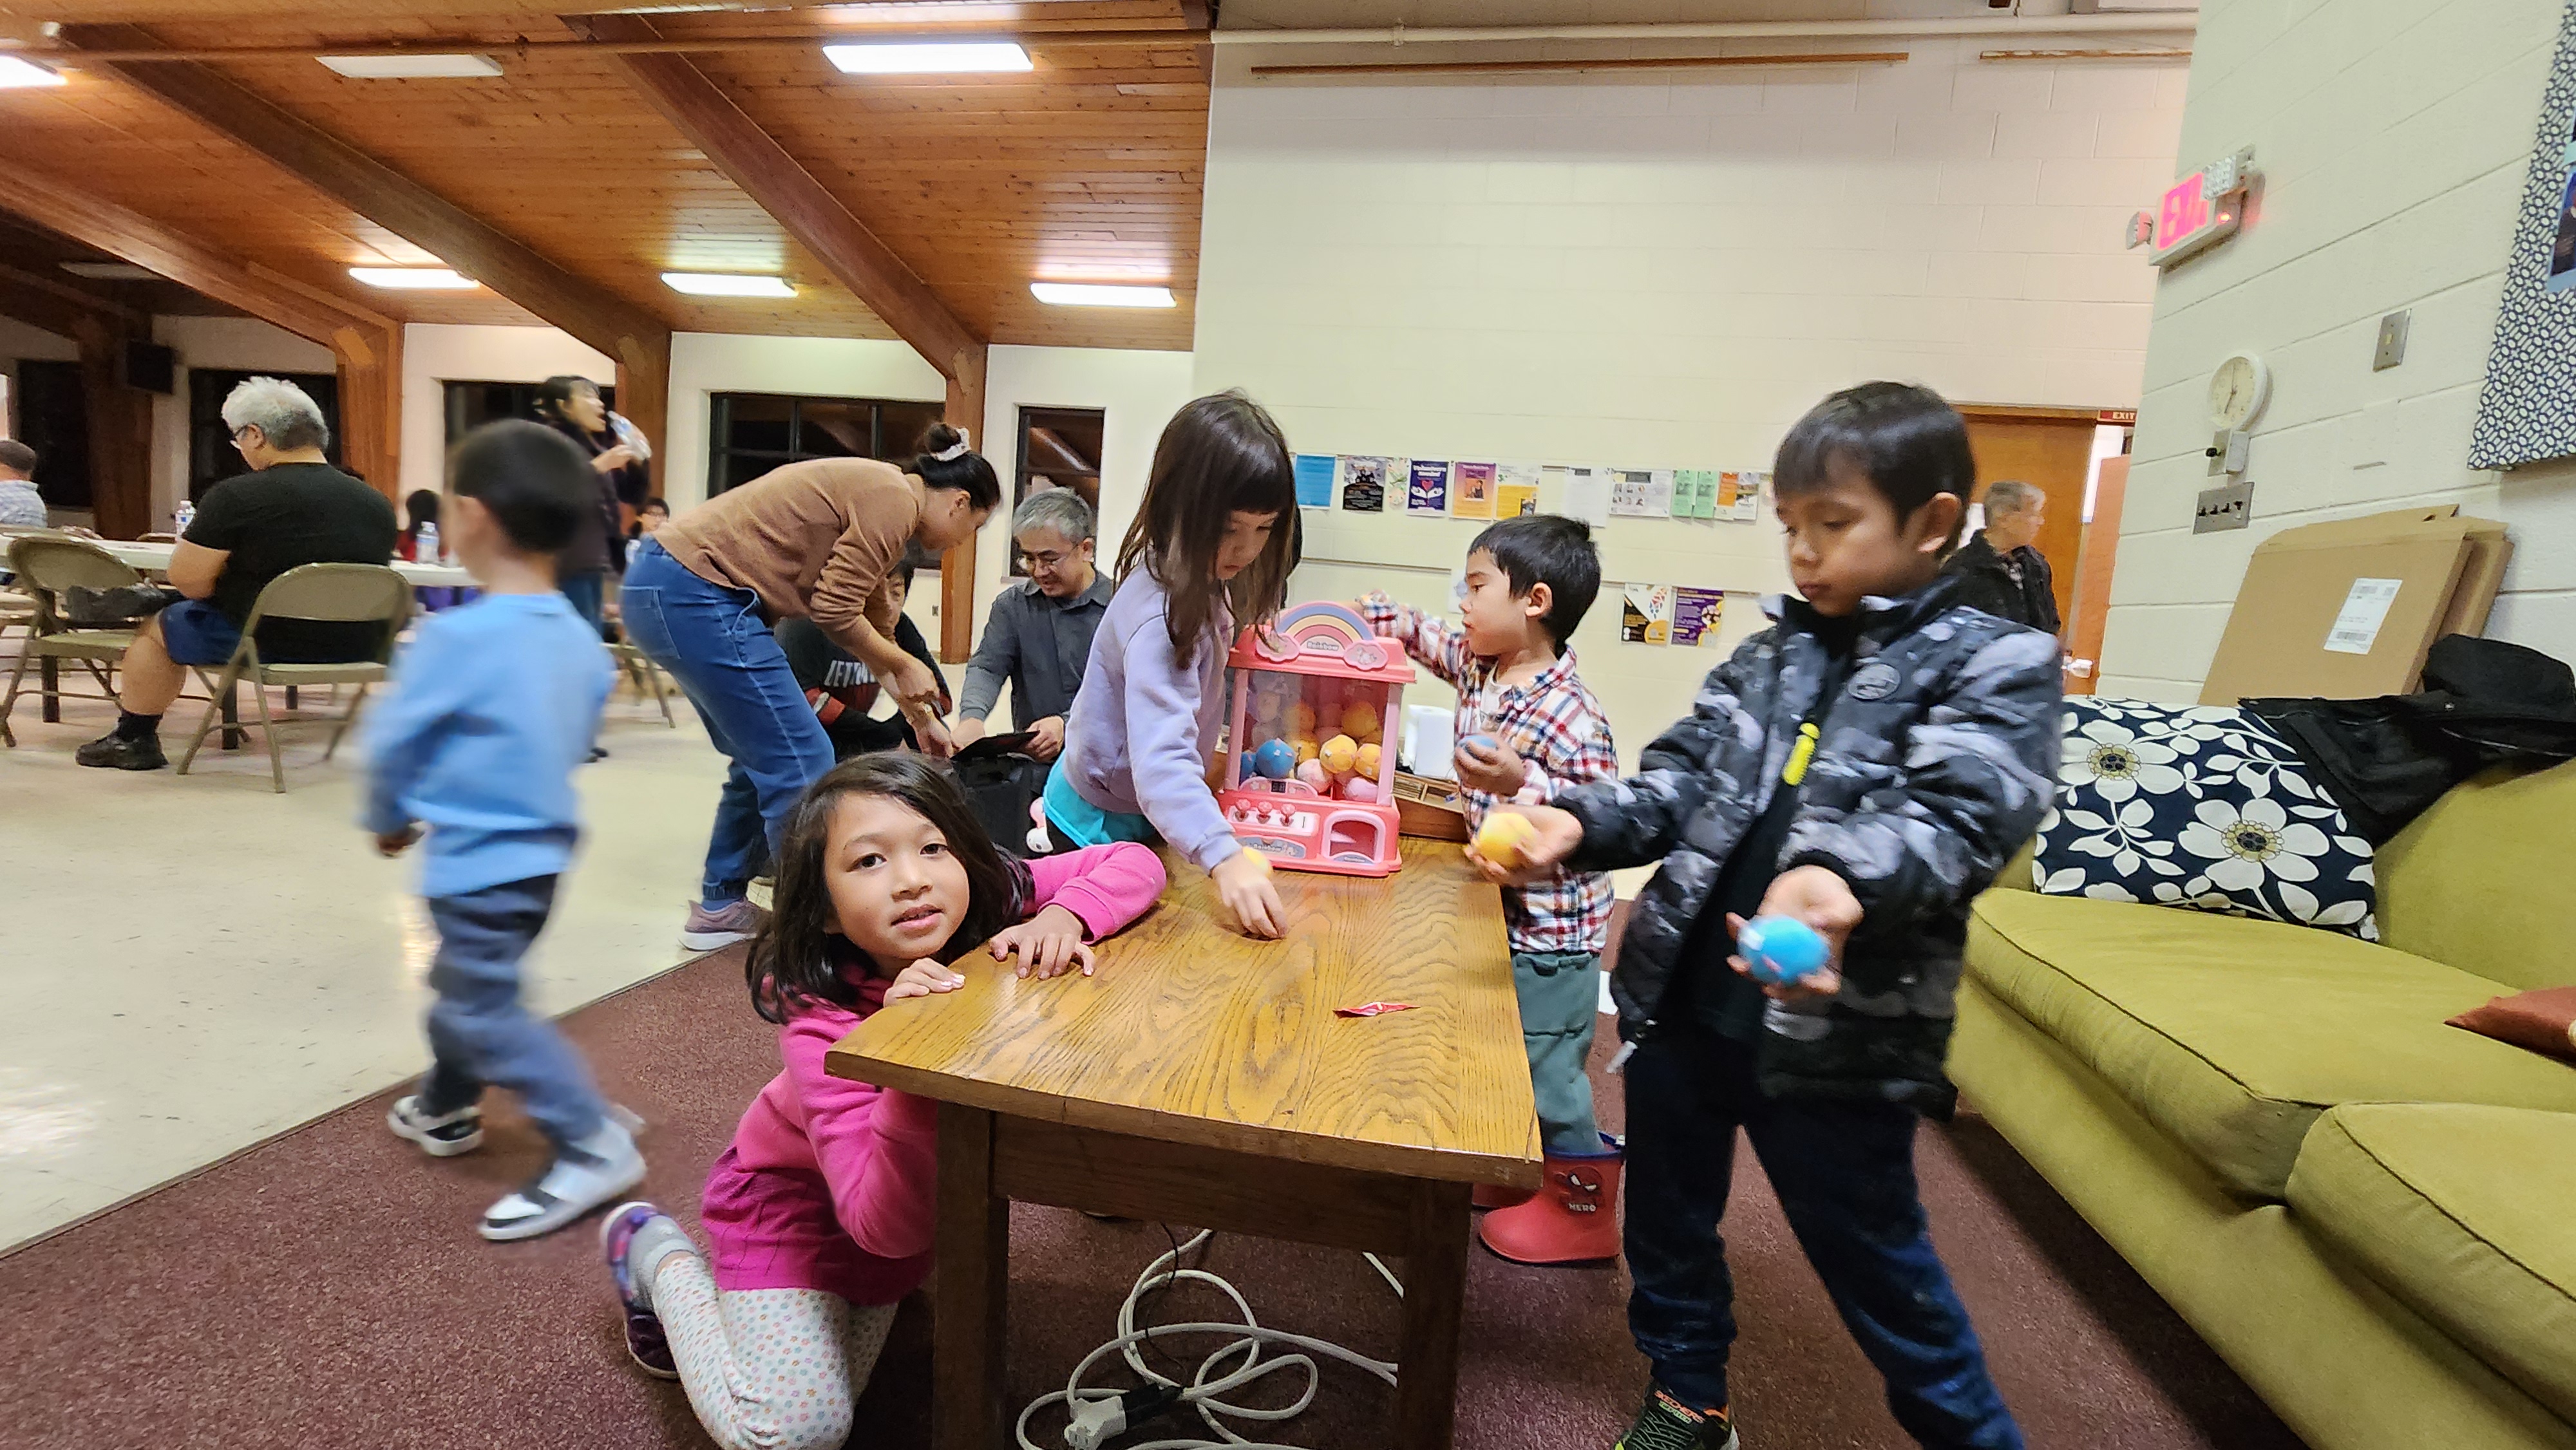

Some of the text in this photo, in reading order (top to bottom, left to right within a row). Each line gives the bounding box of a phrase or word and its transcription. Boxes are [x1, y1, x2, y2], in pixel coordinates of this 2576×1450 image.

[2113, 411, 2135, 420] EXIT
[1307, 641, 1339, 651] Rainbow
[1568, 1203, 1596, 1212] HERO
[1653, 1389, 1705, 1424] SKECHERS
